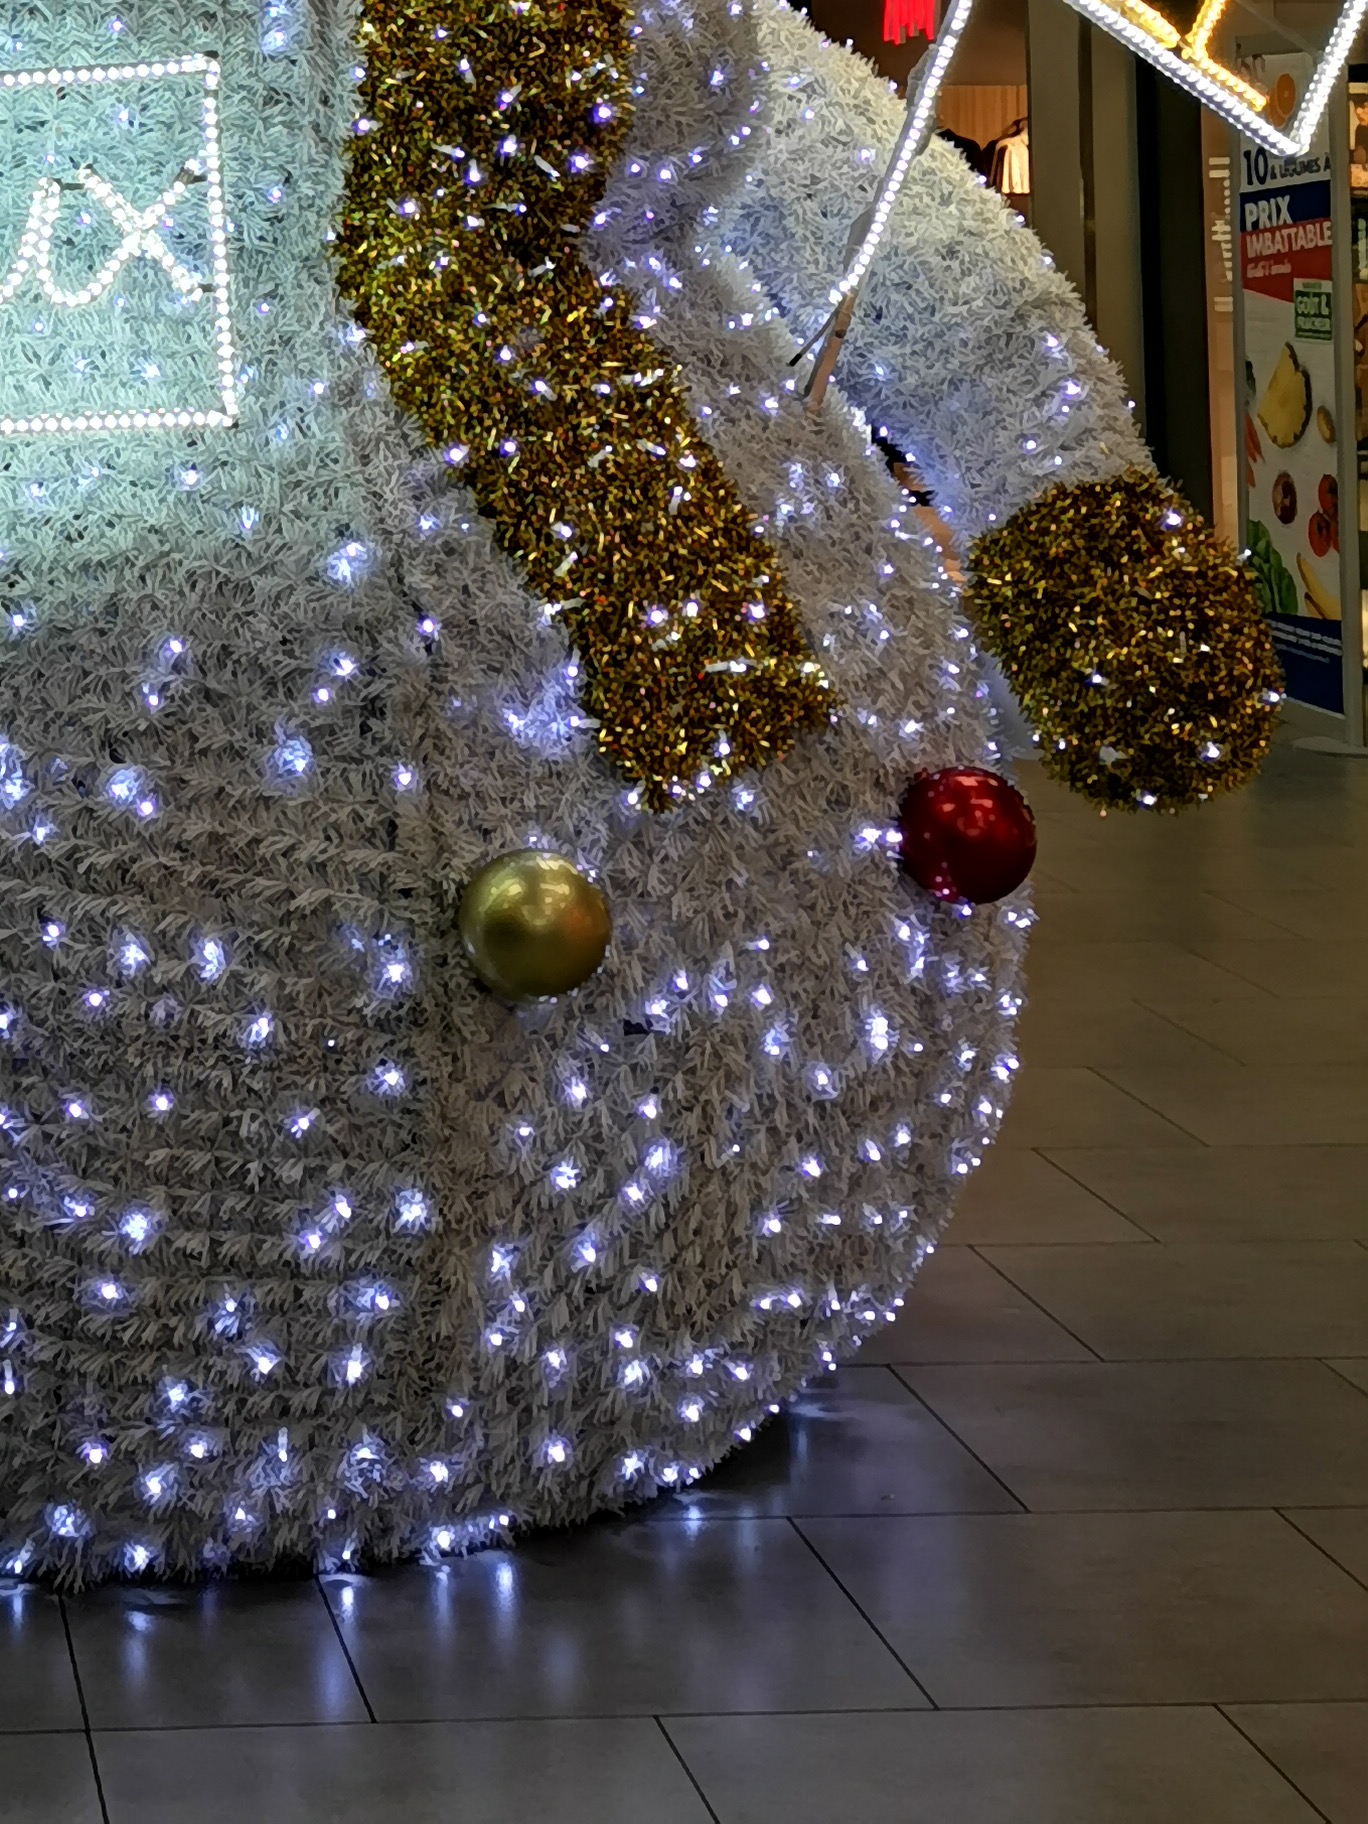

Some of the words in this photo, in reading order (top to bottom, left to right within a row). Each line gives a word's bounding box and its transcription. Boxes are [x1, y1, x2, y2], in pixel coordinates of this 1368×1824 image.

[1243, 147, 1269, 186] 10
[1244, 195, 1294, 232] PRIX
[1246, 221, 1333, 258] IMBATTABLE
